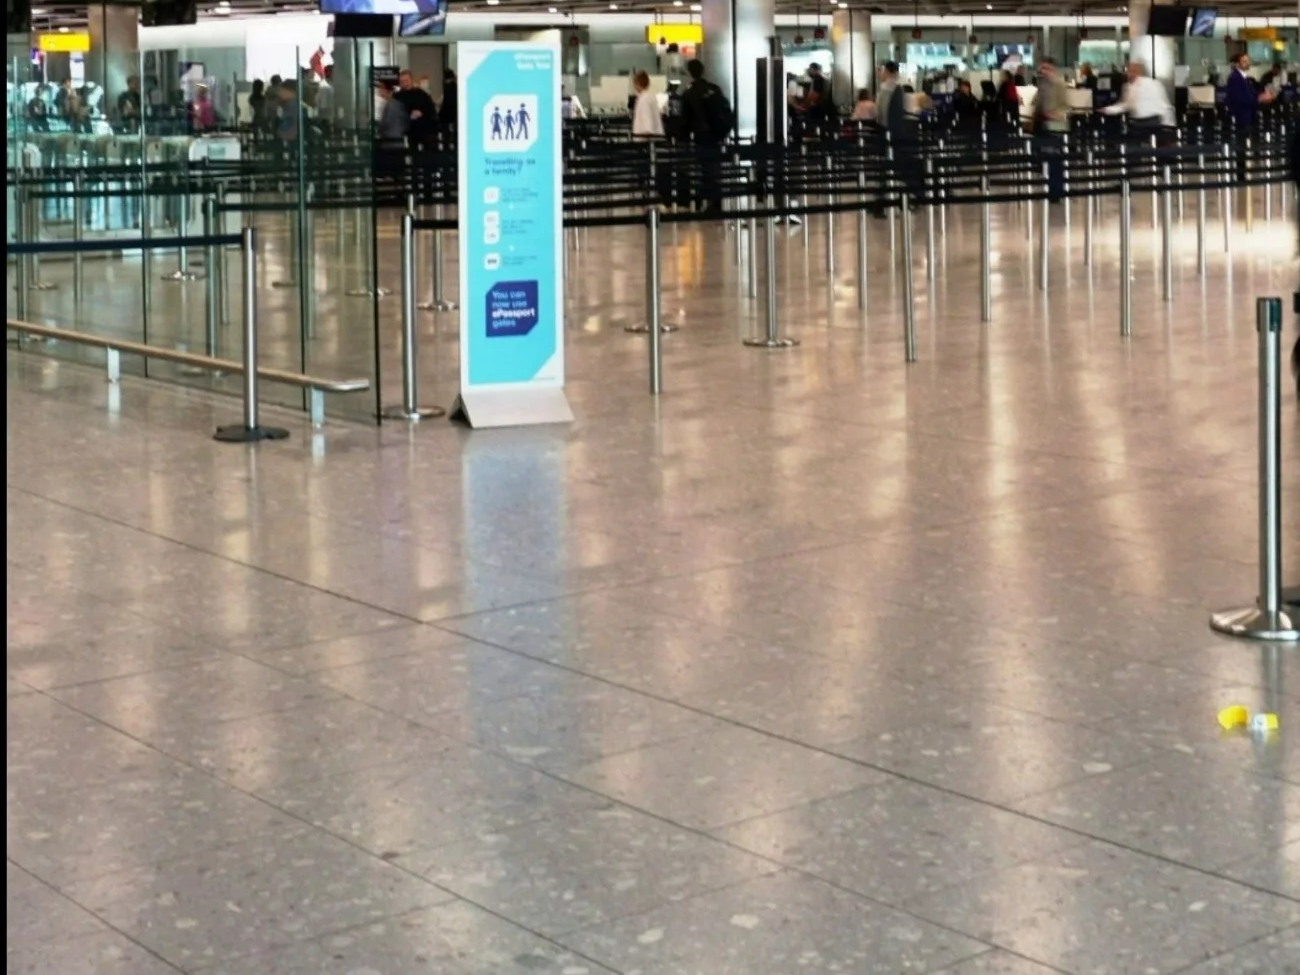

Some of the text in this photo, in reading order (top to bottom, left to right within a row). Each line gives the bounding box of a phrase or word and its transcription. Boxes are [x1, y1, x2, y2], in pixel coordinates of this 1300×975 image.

[492, 290, 526, 300] You can
[491, 300, 528, 309] now use
[491, 307, 536, 319] ePassport
[491, 319, 517, 330] gates
